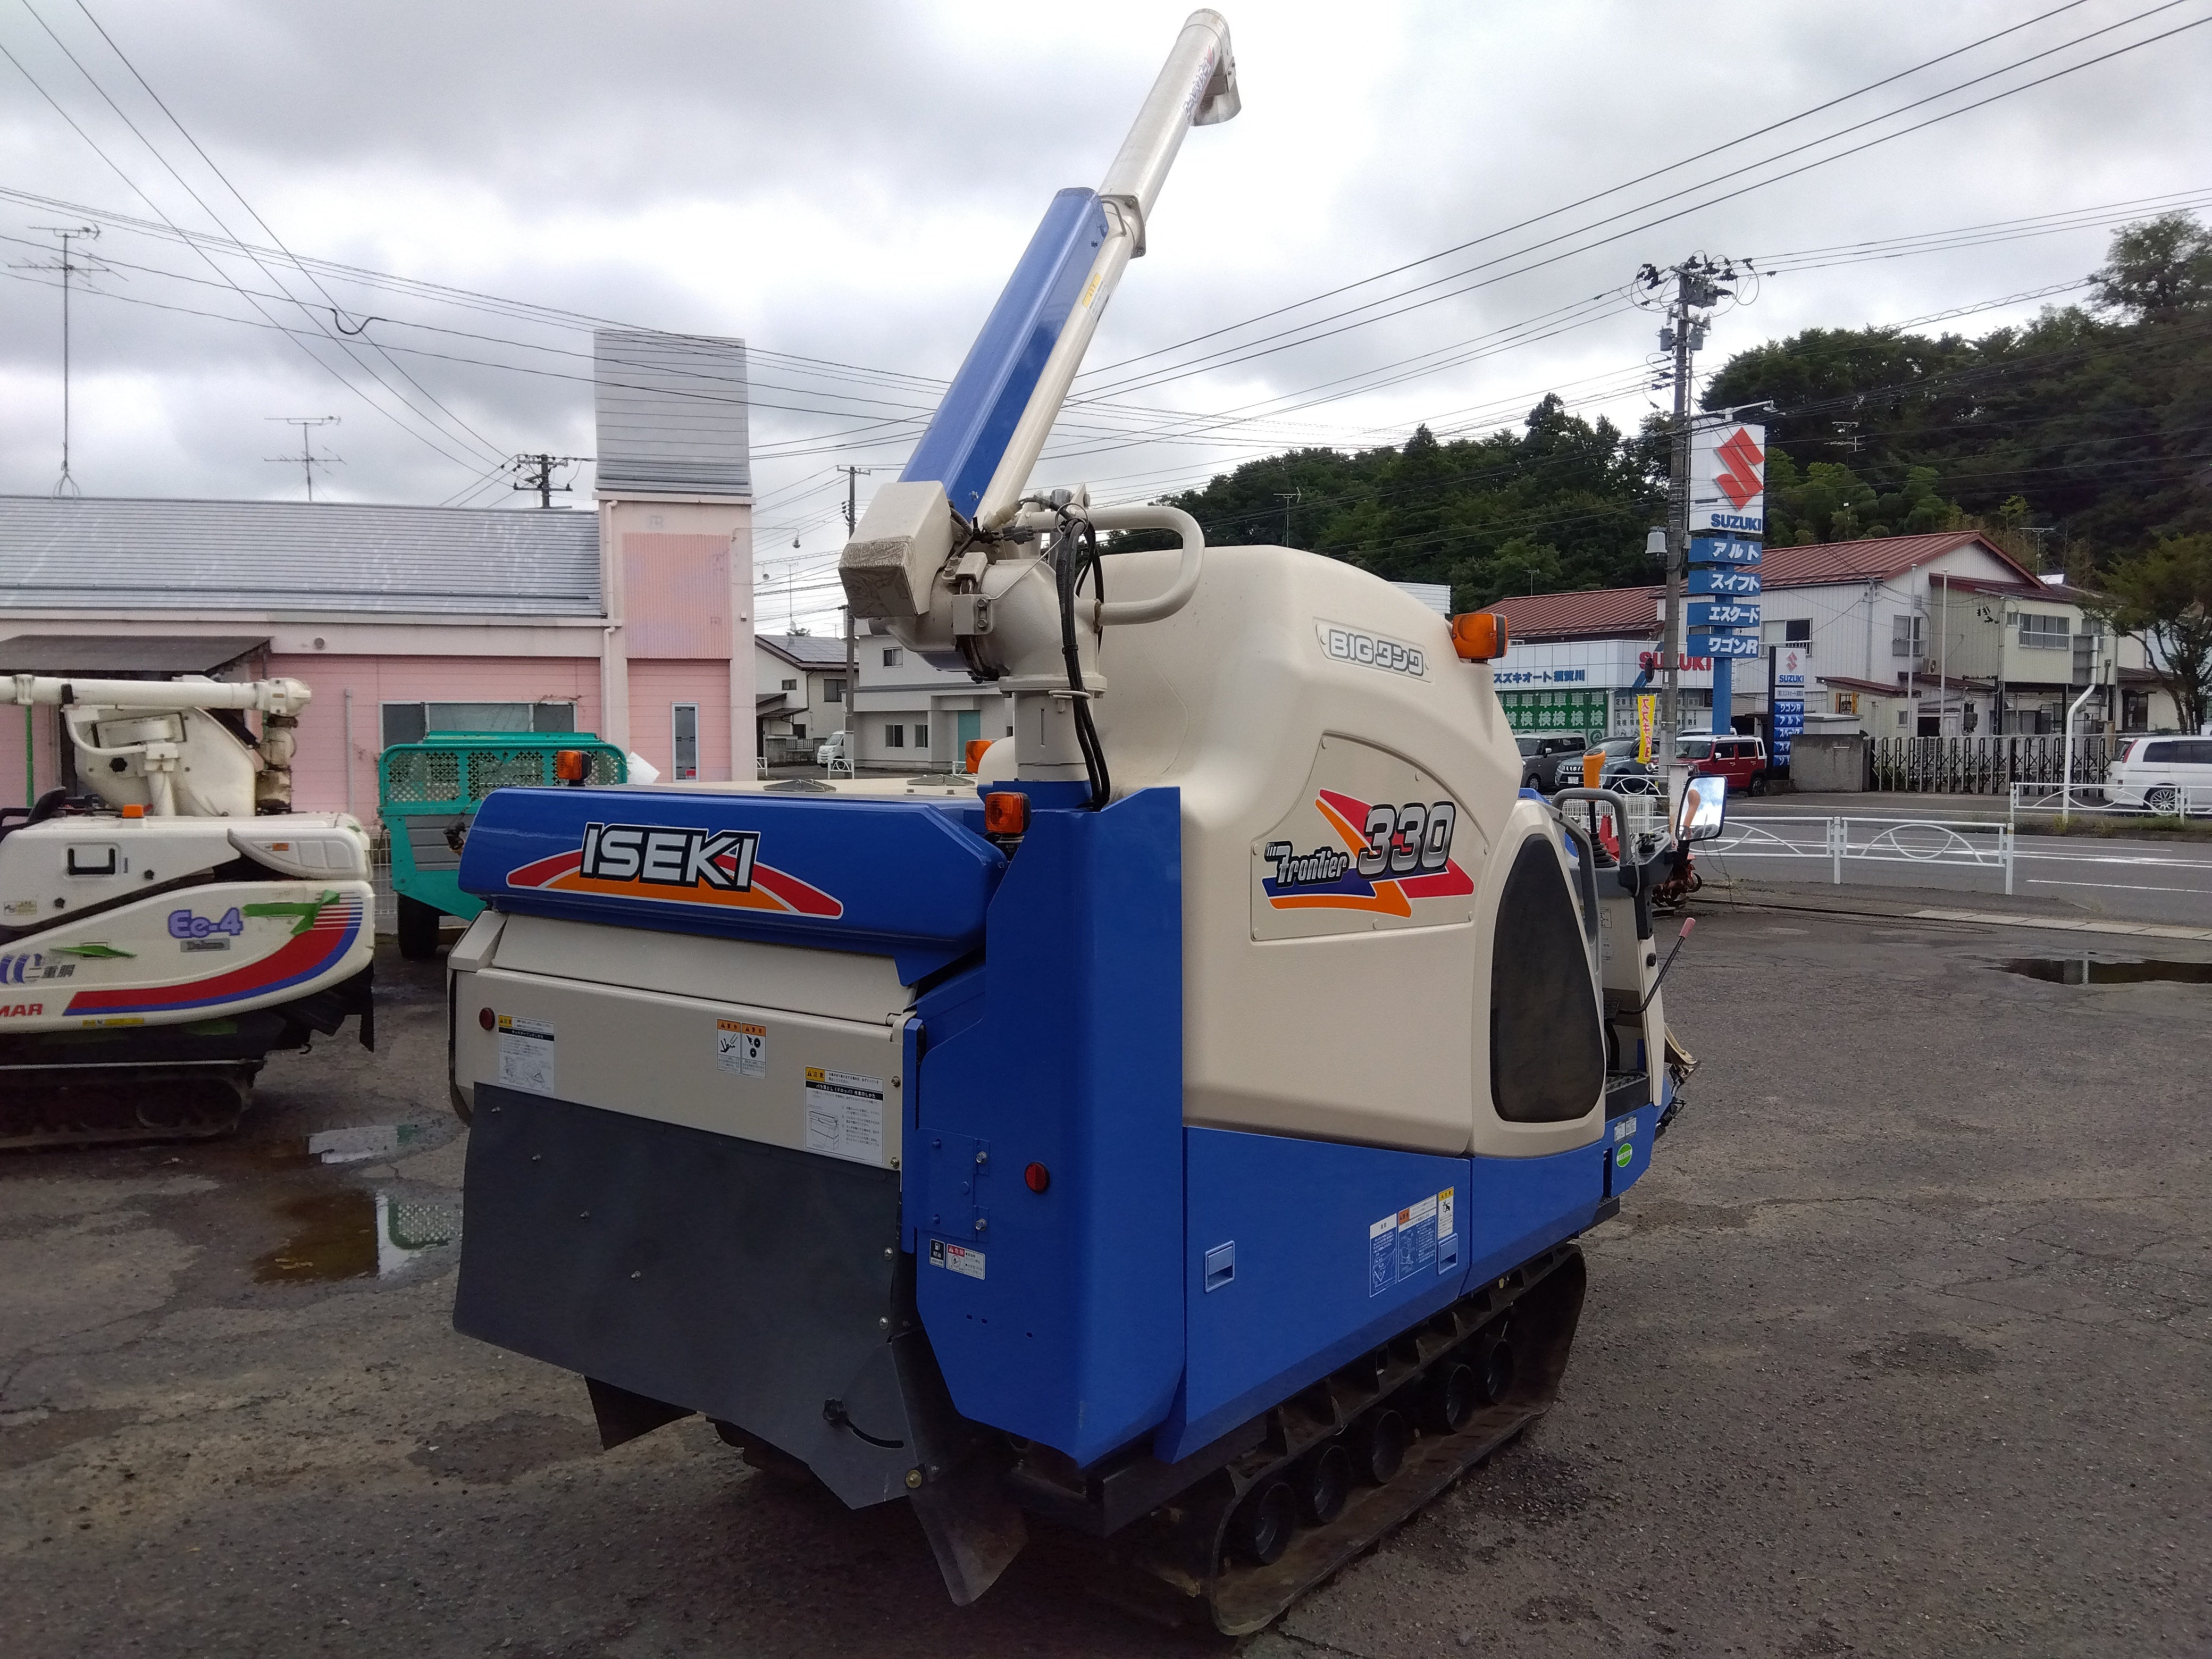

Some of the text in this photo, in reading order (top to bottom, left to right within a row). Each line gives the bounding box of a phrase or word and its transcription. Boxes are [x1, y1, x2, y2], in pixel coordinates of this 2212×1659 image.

[1711, 513, 1762, 531] SUZUKI
[1713, 542, 1759, 561] アルト
[1710, 574, 1760, 592] スイフト
[1708, 606, 1760, 623] エスクード
[1329, 629, 1424, 676] BIG タンク
[1708, 638, 1758, 655] ワゴンR
[1639, 651, 1712, 671] SUUKI
[1779, 674, 1804, 683] SUZUKI
[1780, 703, 1801, 713] ワゴンR
[1779, 716, 1800, 725] アルト
[1779, 742, 1790, 752] スイ
[1266, 801, 1456, 886] Frontier 330
[581, 824, 758, 891] ISEKI
[167, 907, 244, 938] Ee-4
